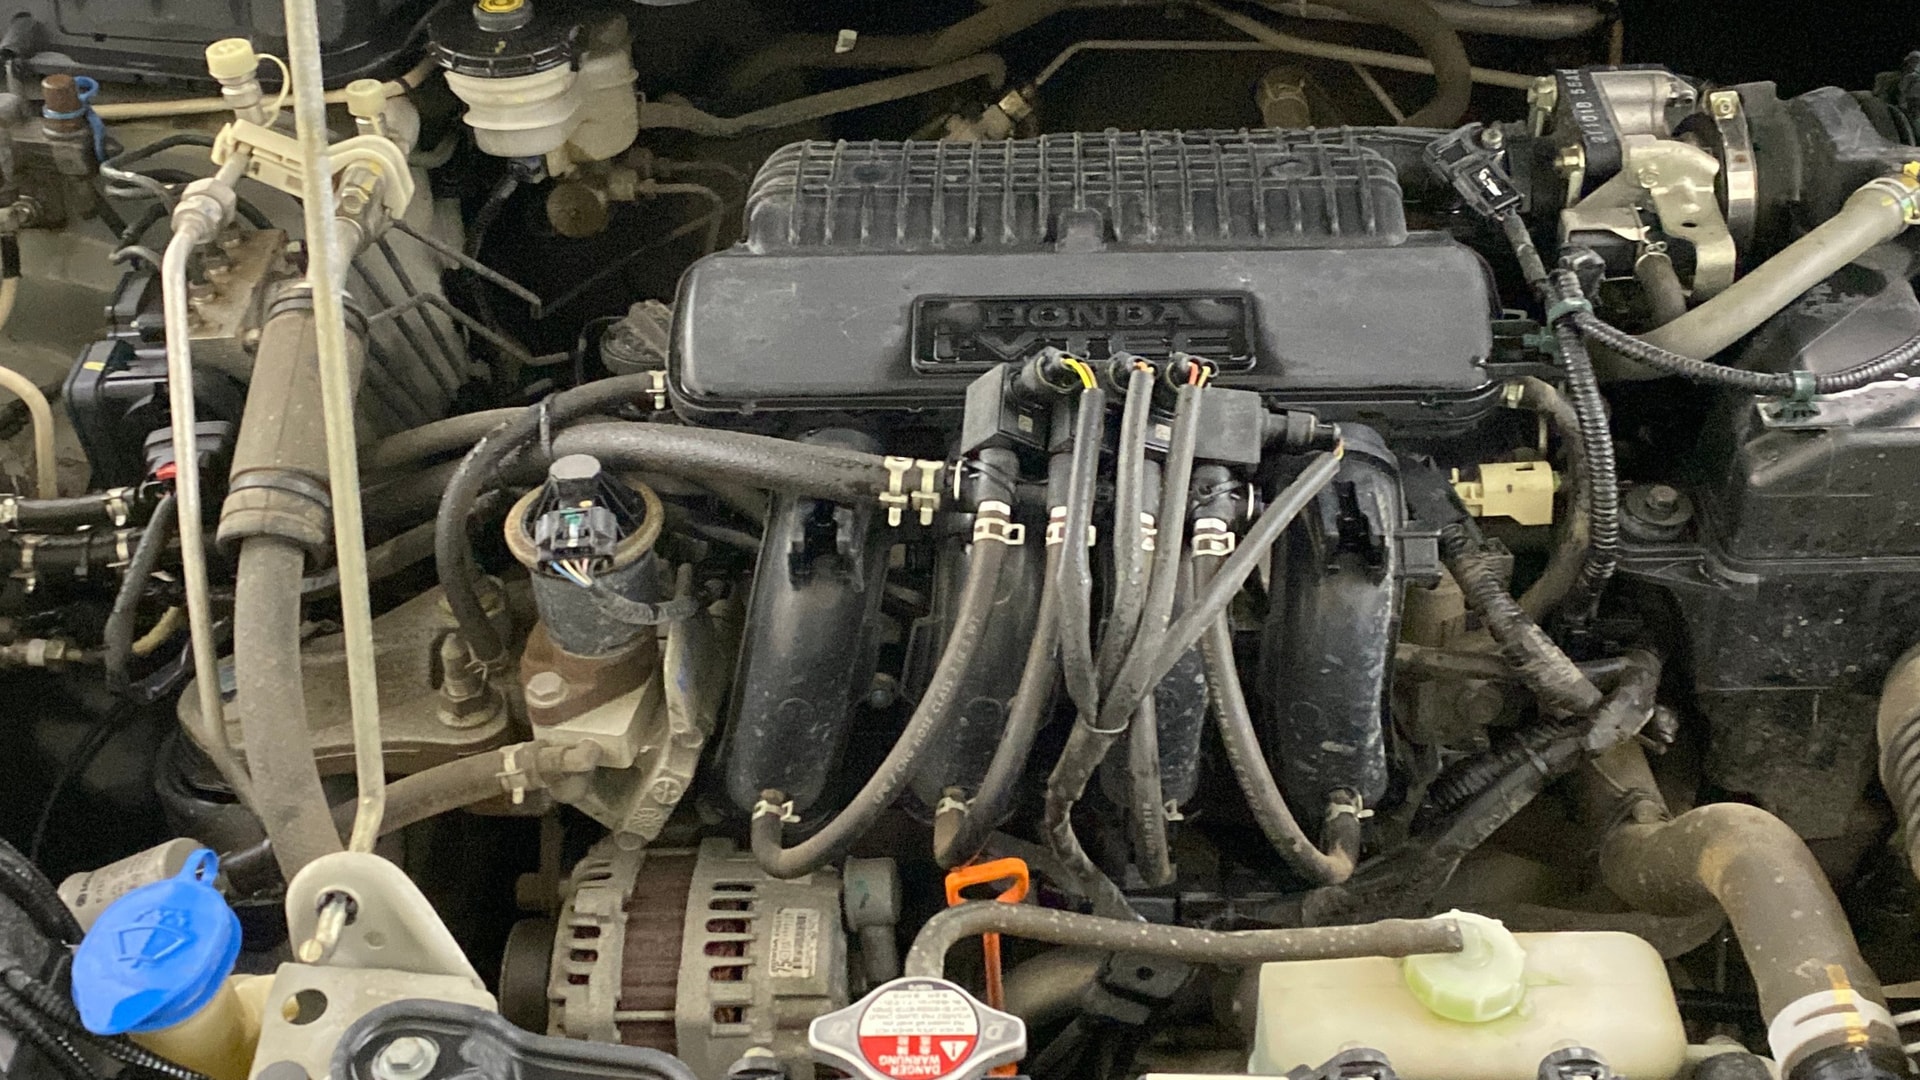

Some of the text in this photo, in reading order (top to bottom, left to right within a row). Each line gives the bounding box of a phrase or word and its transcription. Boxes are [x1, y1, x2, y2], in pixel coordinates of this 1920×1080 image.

[983, 303, 1197, 327] HONDA
[931, 680, 953, 713] CLASS
[878, 1054, 940, 1067] WARNUNG
[889, 1064, 940, 1076] DANGER
